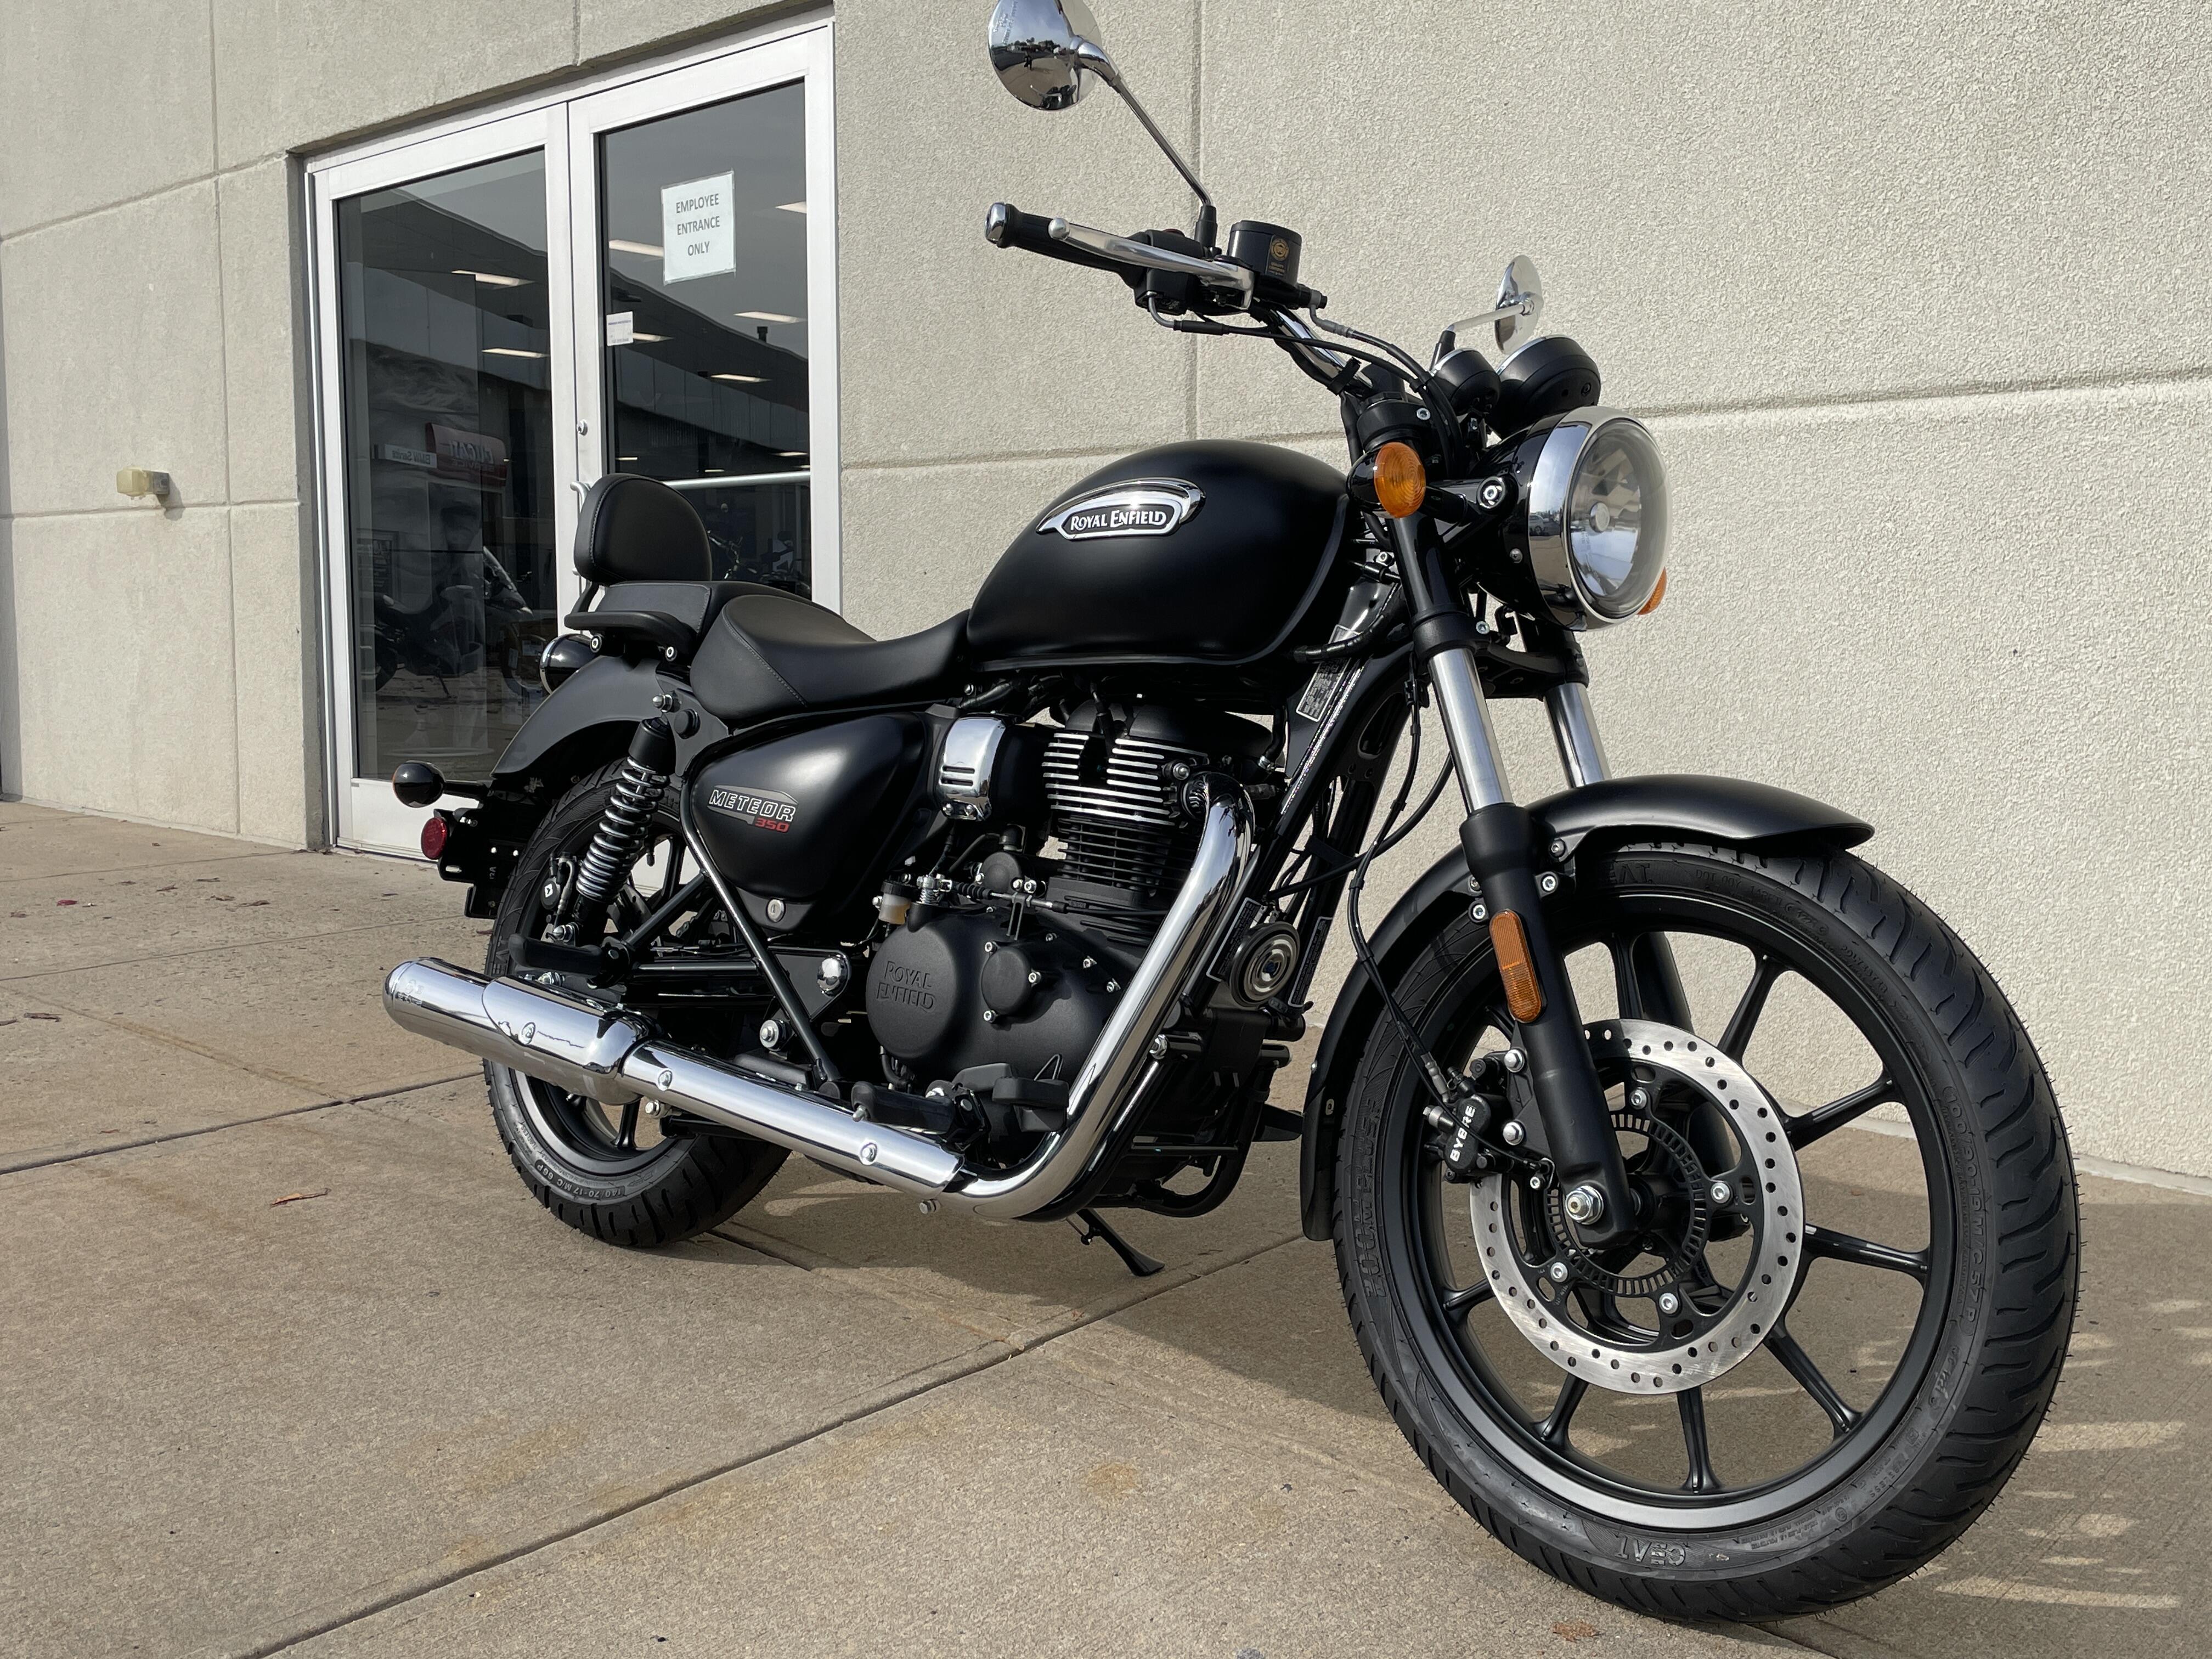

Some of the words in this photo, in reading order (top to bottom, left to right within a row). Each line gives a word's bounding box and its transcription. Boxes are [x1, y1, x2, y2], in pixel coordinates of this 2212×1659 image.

[676, 193, 719, 213] EMPLOYEE
[677, 216, 720, 235] ENTRANCE
[687, 241, 710, 256] ONLY
[1070, 514, 1108, 531] ROYAL
[1109, 510, 1167, 528] ENFIELD
[709, 789, 796, 822] METEOR
[754, 817, 790, 833] 350
[1695, 869, 1717, 883] DOT
[884, 960, 932, 989] ROYAL
[876, 981, 936, 1012] ENFIELD
[1449, 1104, 1476, 1162] BYBRE
[536, 1163, 554, 1181] 66P
[556, 1178, 572, 1191] M/C
[573, 1187, 622, 1198] 140/70-17
[1353, 1198, 1387, 1298] ZOOM
[1615, 1536, 1685, 1566] CEAT
